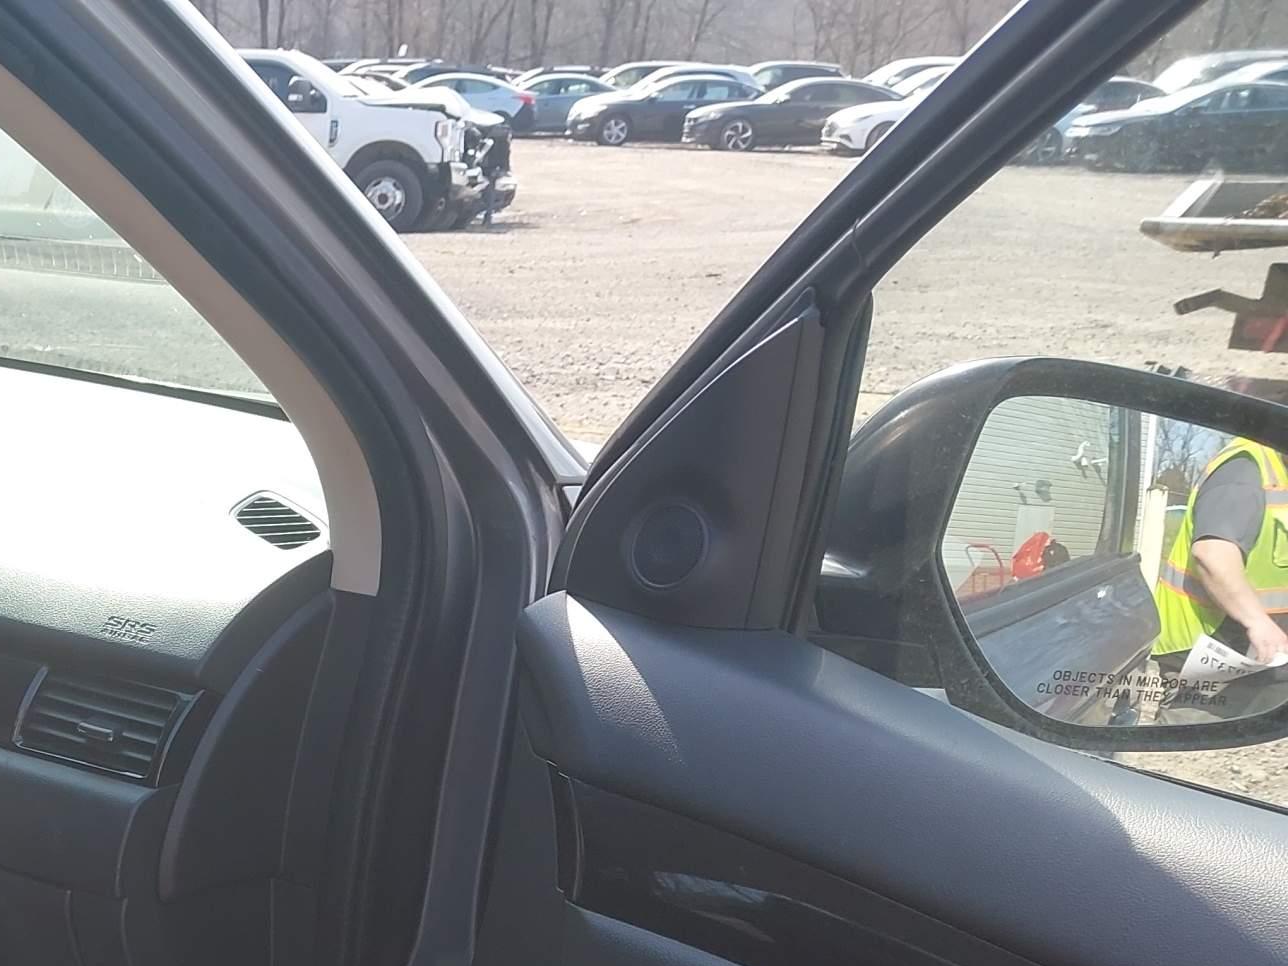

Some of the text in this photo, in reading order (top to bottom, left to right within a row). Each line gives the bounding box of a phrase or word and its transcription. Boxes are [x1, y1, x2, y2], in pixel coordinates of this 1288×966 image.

[104, 615, 158, 634] SRS
[1052, 670, 1219, 692] OBJECTS IN MIRROR ARE
[1036, 682, 1227, 706] CLOSER THAN THEY APPEAR
